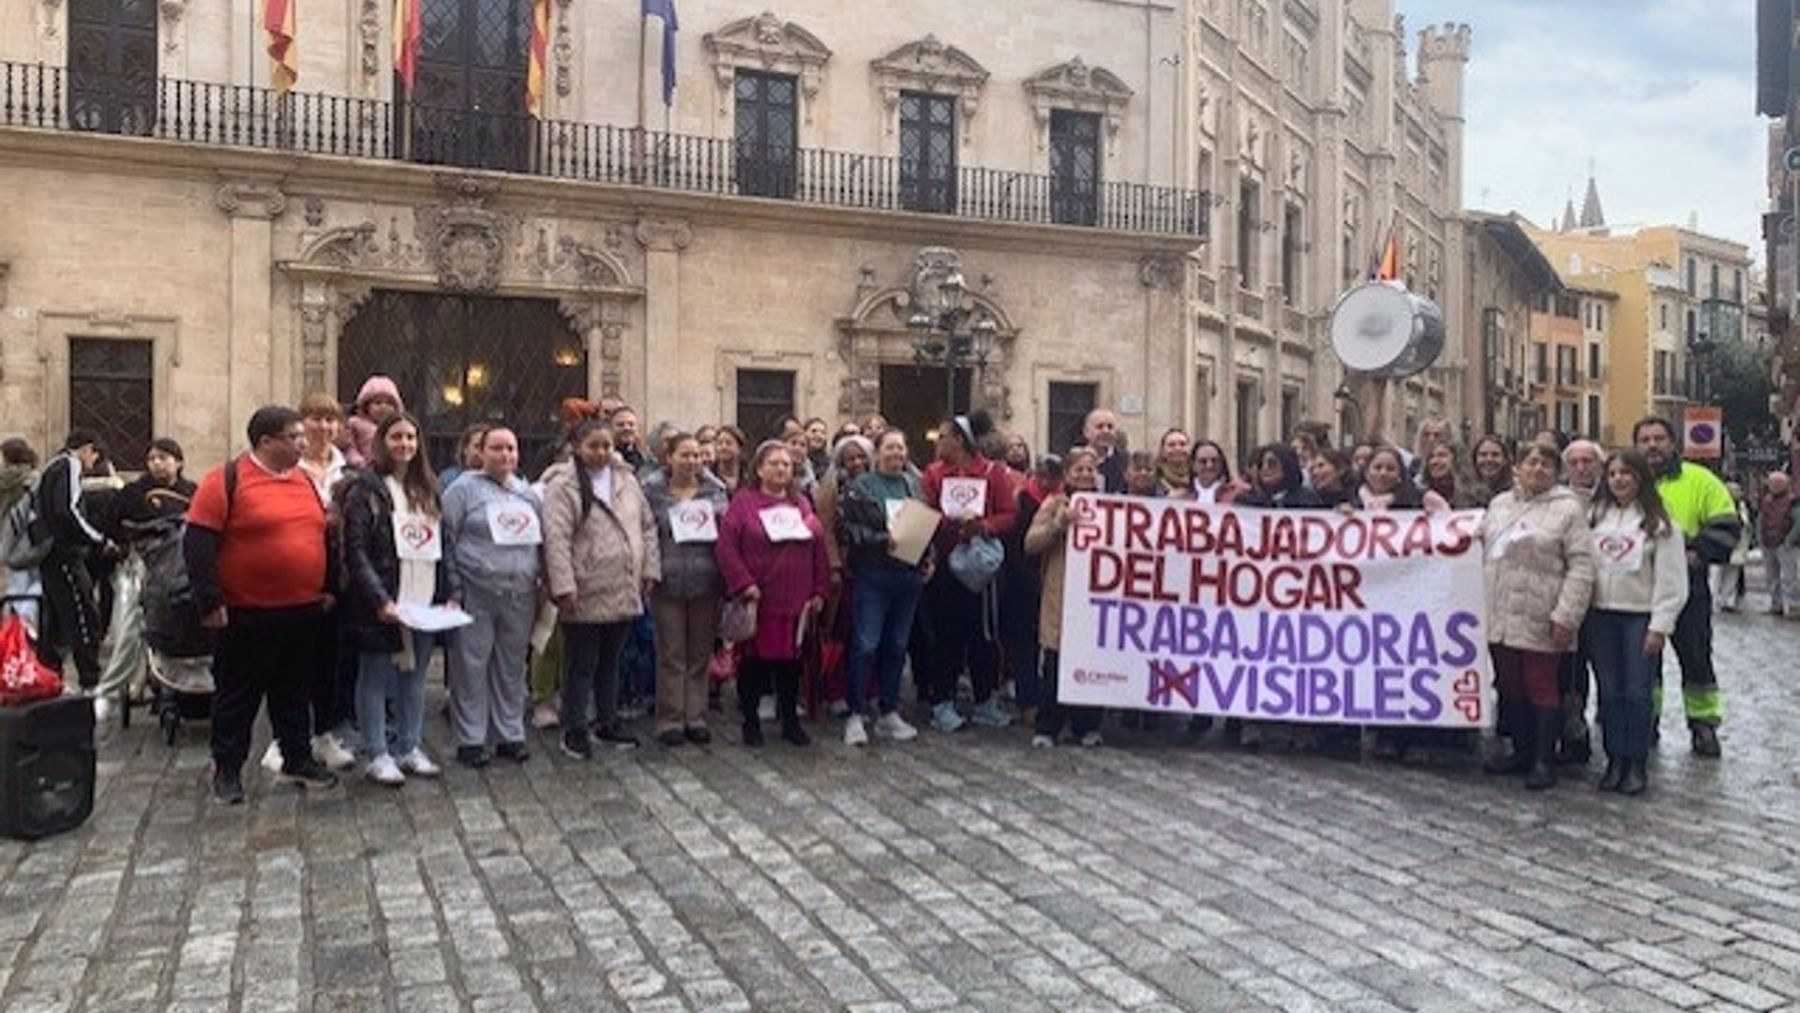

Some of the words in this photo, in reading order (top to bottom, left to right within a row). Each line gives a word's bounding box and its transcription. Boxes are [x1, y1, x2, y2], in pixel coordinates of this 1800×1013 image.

[1097, 499, 1474, 561] TRABAJADORAS
[1090, 550, 1179, 602] DEL
[1190, 558, 1365, 610] HOGAR
[1090, 598, 1479, 667] TRABAJADORAS
